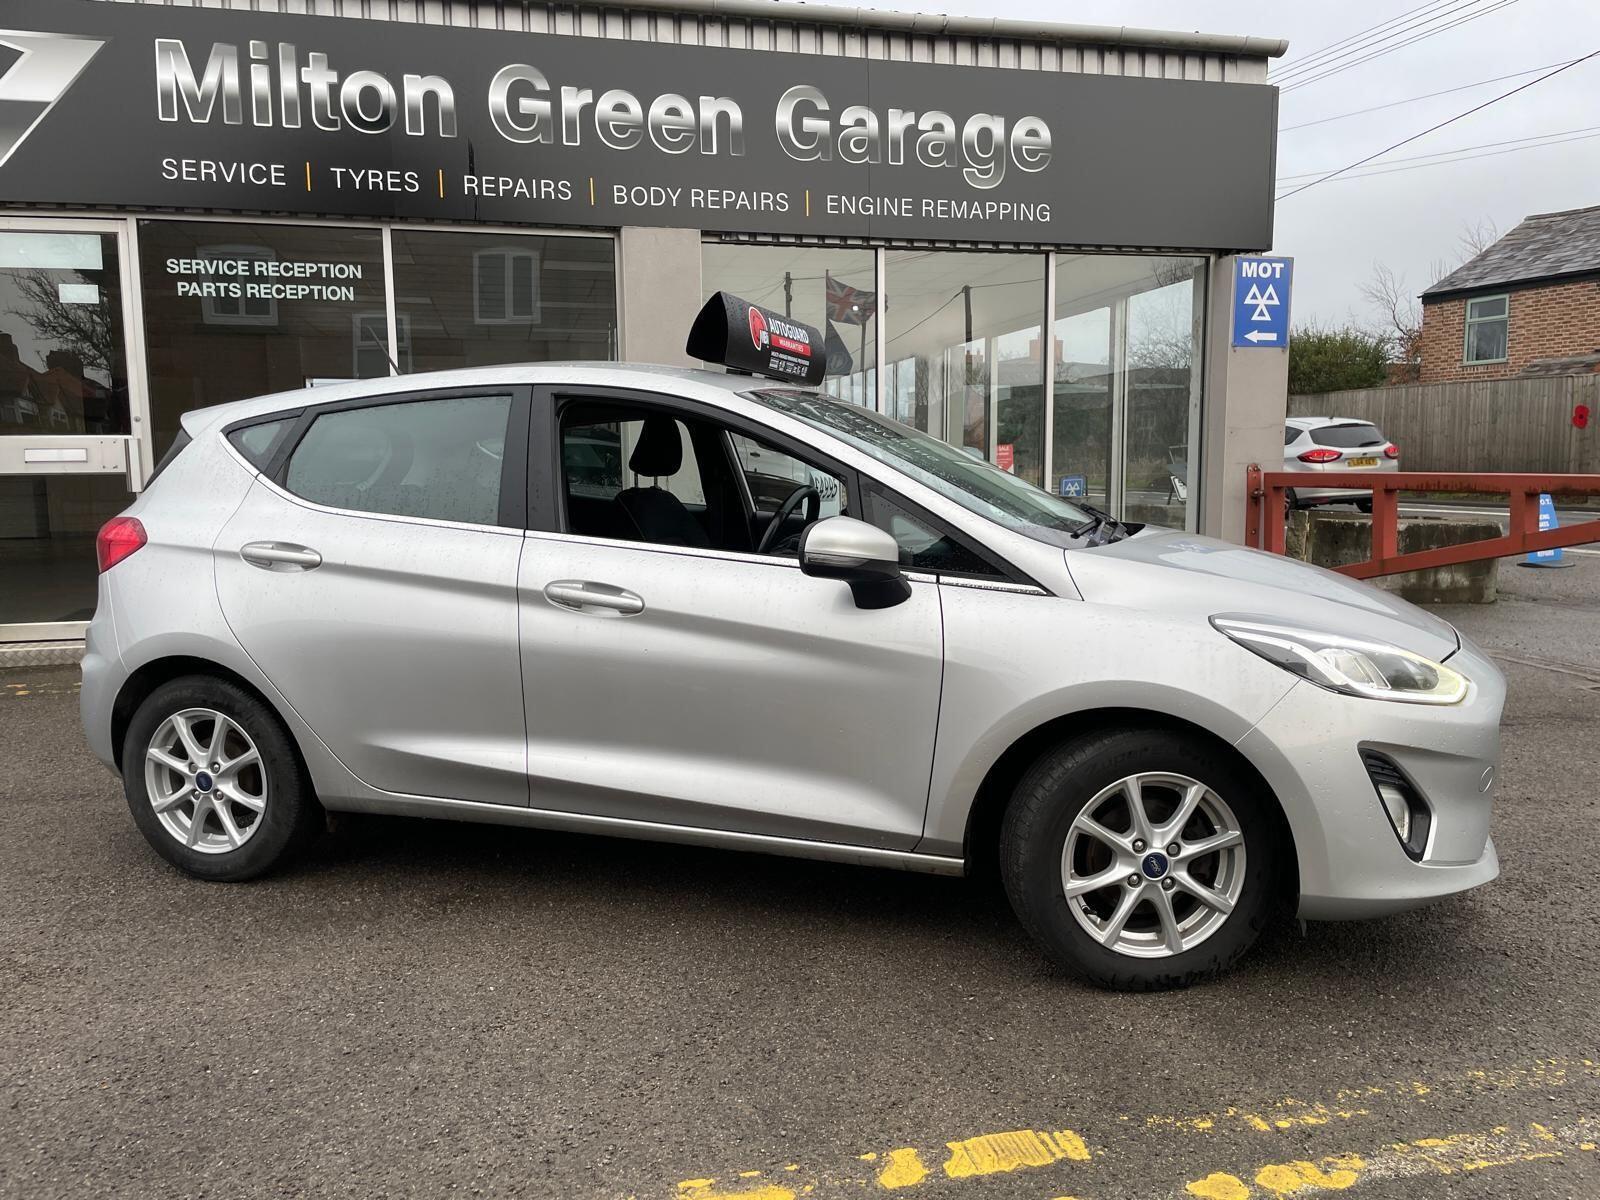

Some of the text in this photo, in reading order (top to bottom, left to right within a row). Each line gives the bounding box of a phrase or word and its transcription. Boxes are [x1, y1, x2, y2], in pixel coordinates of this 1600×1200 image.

[154, 38, 1053, 190] Milton Green Garage
[161, 157, 1052, 223] SERVICE TYRES REPAIRS BODY REPAIRS ENGINE REMAPPING
[166, 258, 363, 281] SERVICE RECEPTION
[1241, 261, 1285, 279] MOT
[176, 280, 355, 302] PARTS RECEPTION
[768, 317, 810, 344] AUTOGUARD
